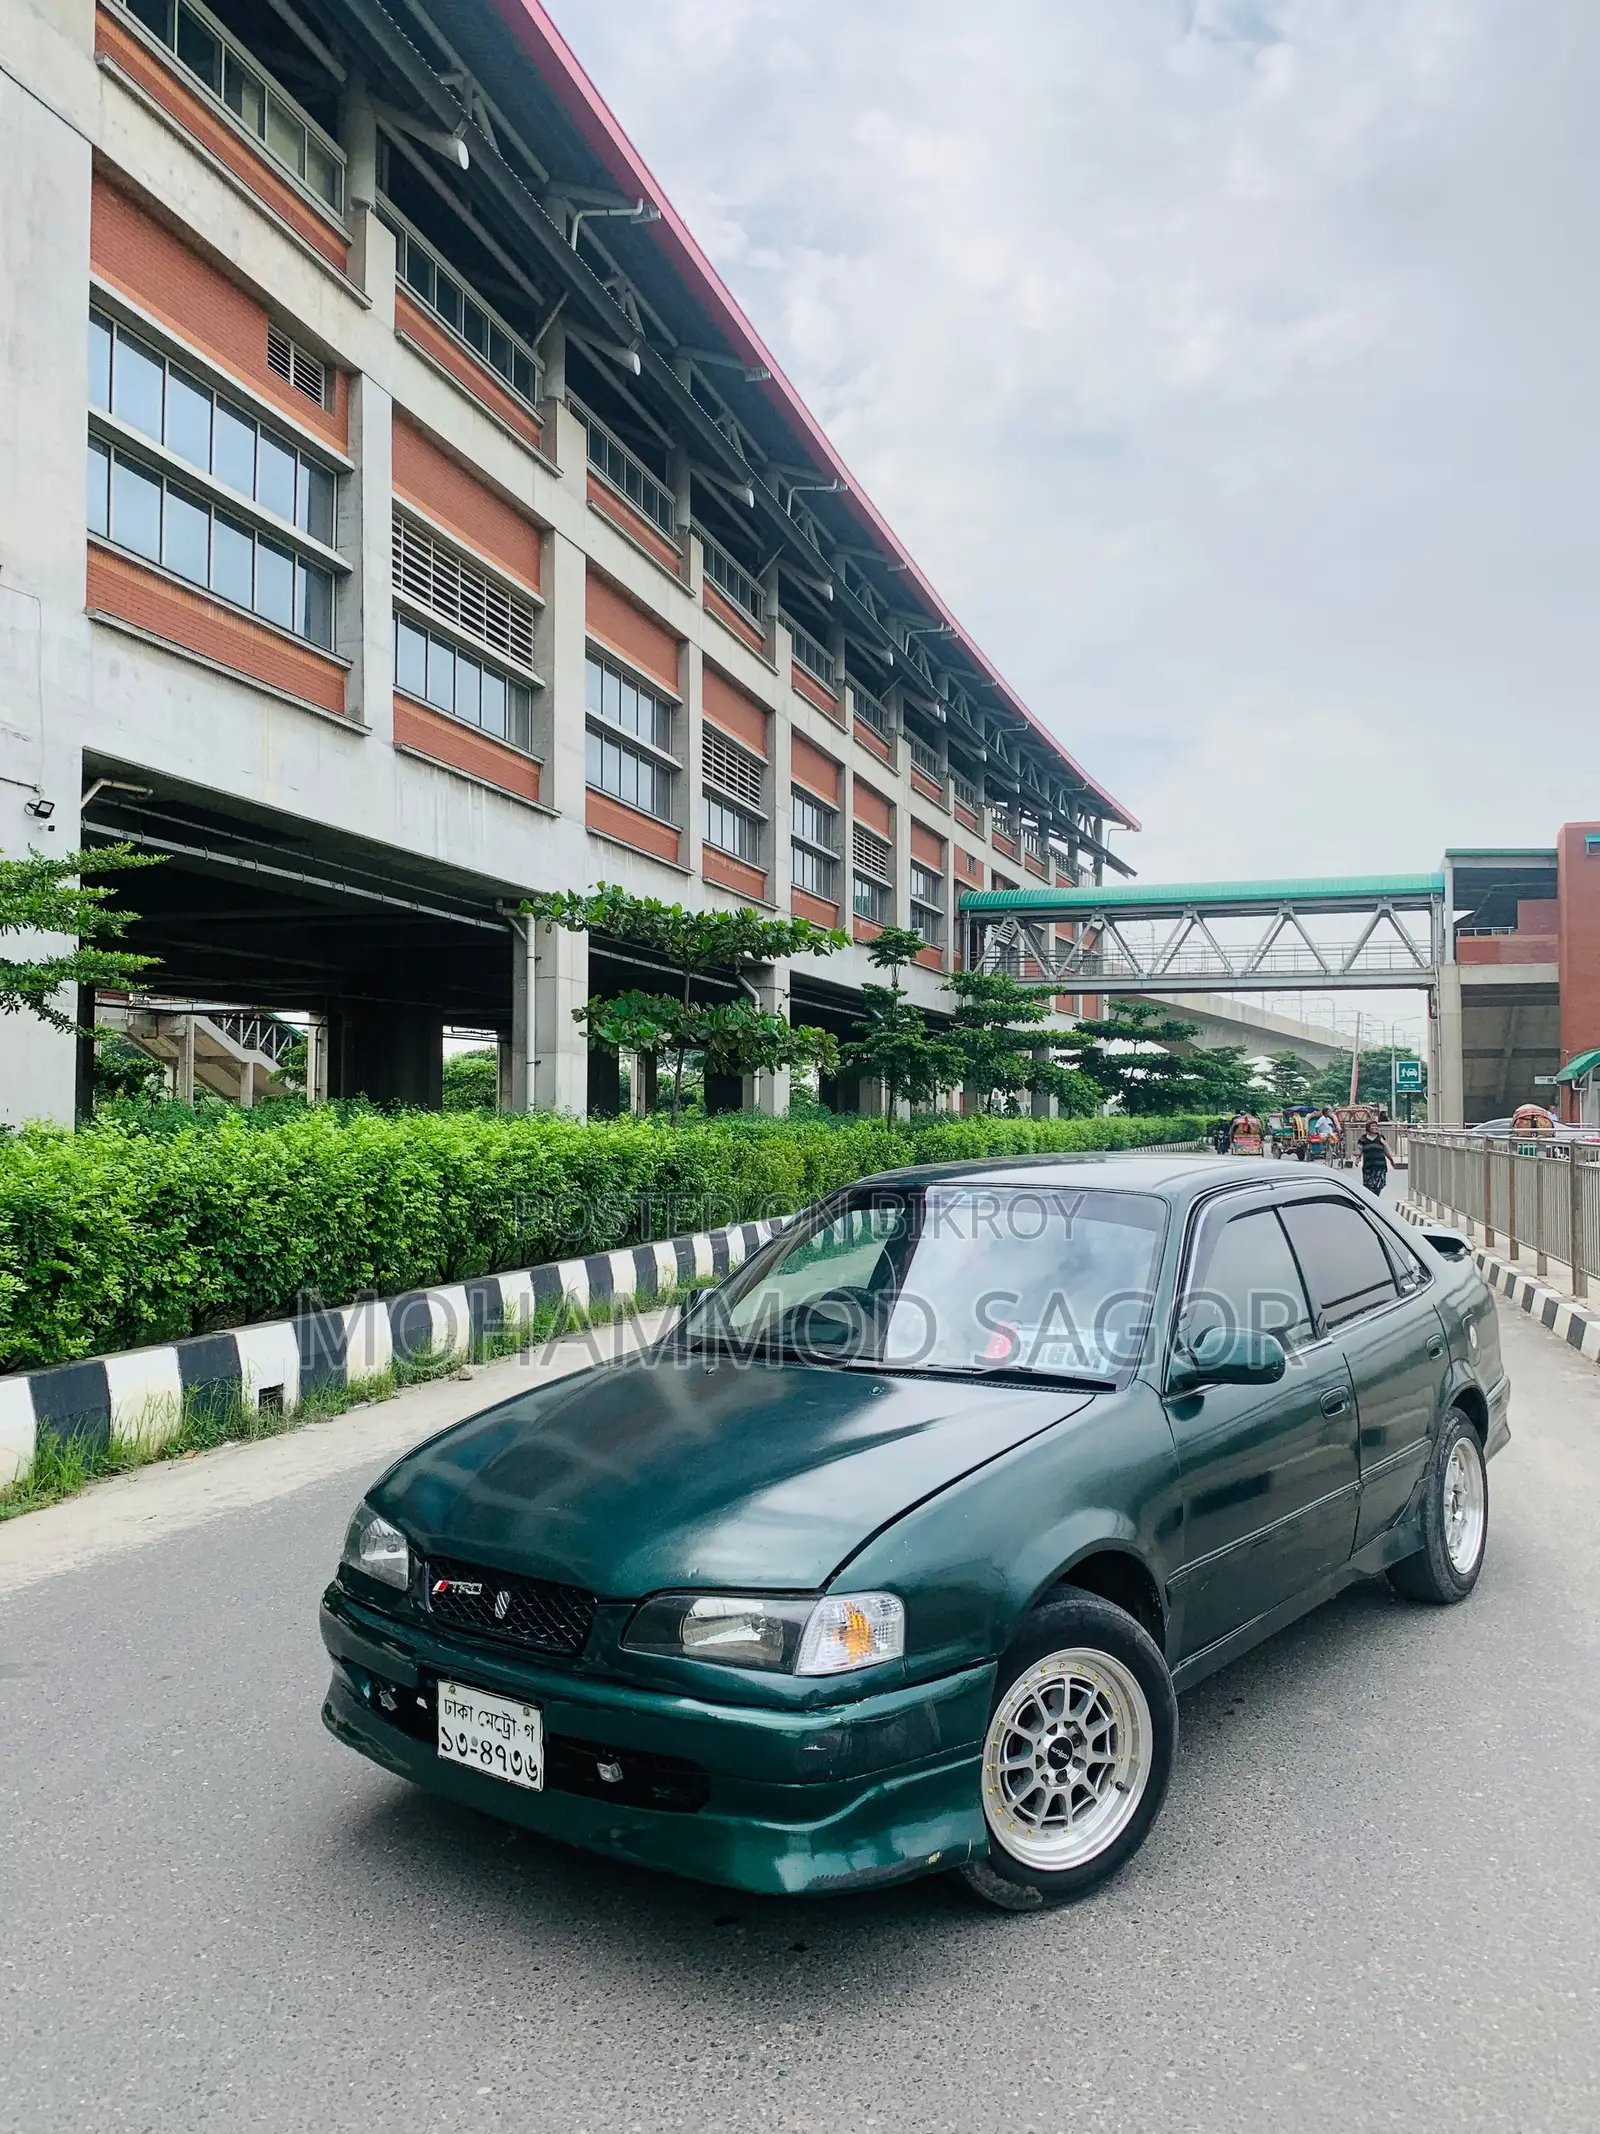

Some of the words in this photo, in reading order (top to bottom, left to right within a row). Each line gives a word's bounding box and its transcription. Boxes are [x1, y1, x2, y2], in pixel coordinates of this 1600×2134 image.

[446, 1581, 483, 1595] TRD
[444, 1699, 473, 1722] ঢাকা
[441, 1726, 539, 1781] ১৩-৪৭৩৬
